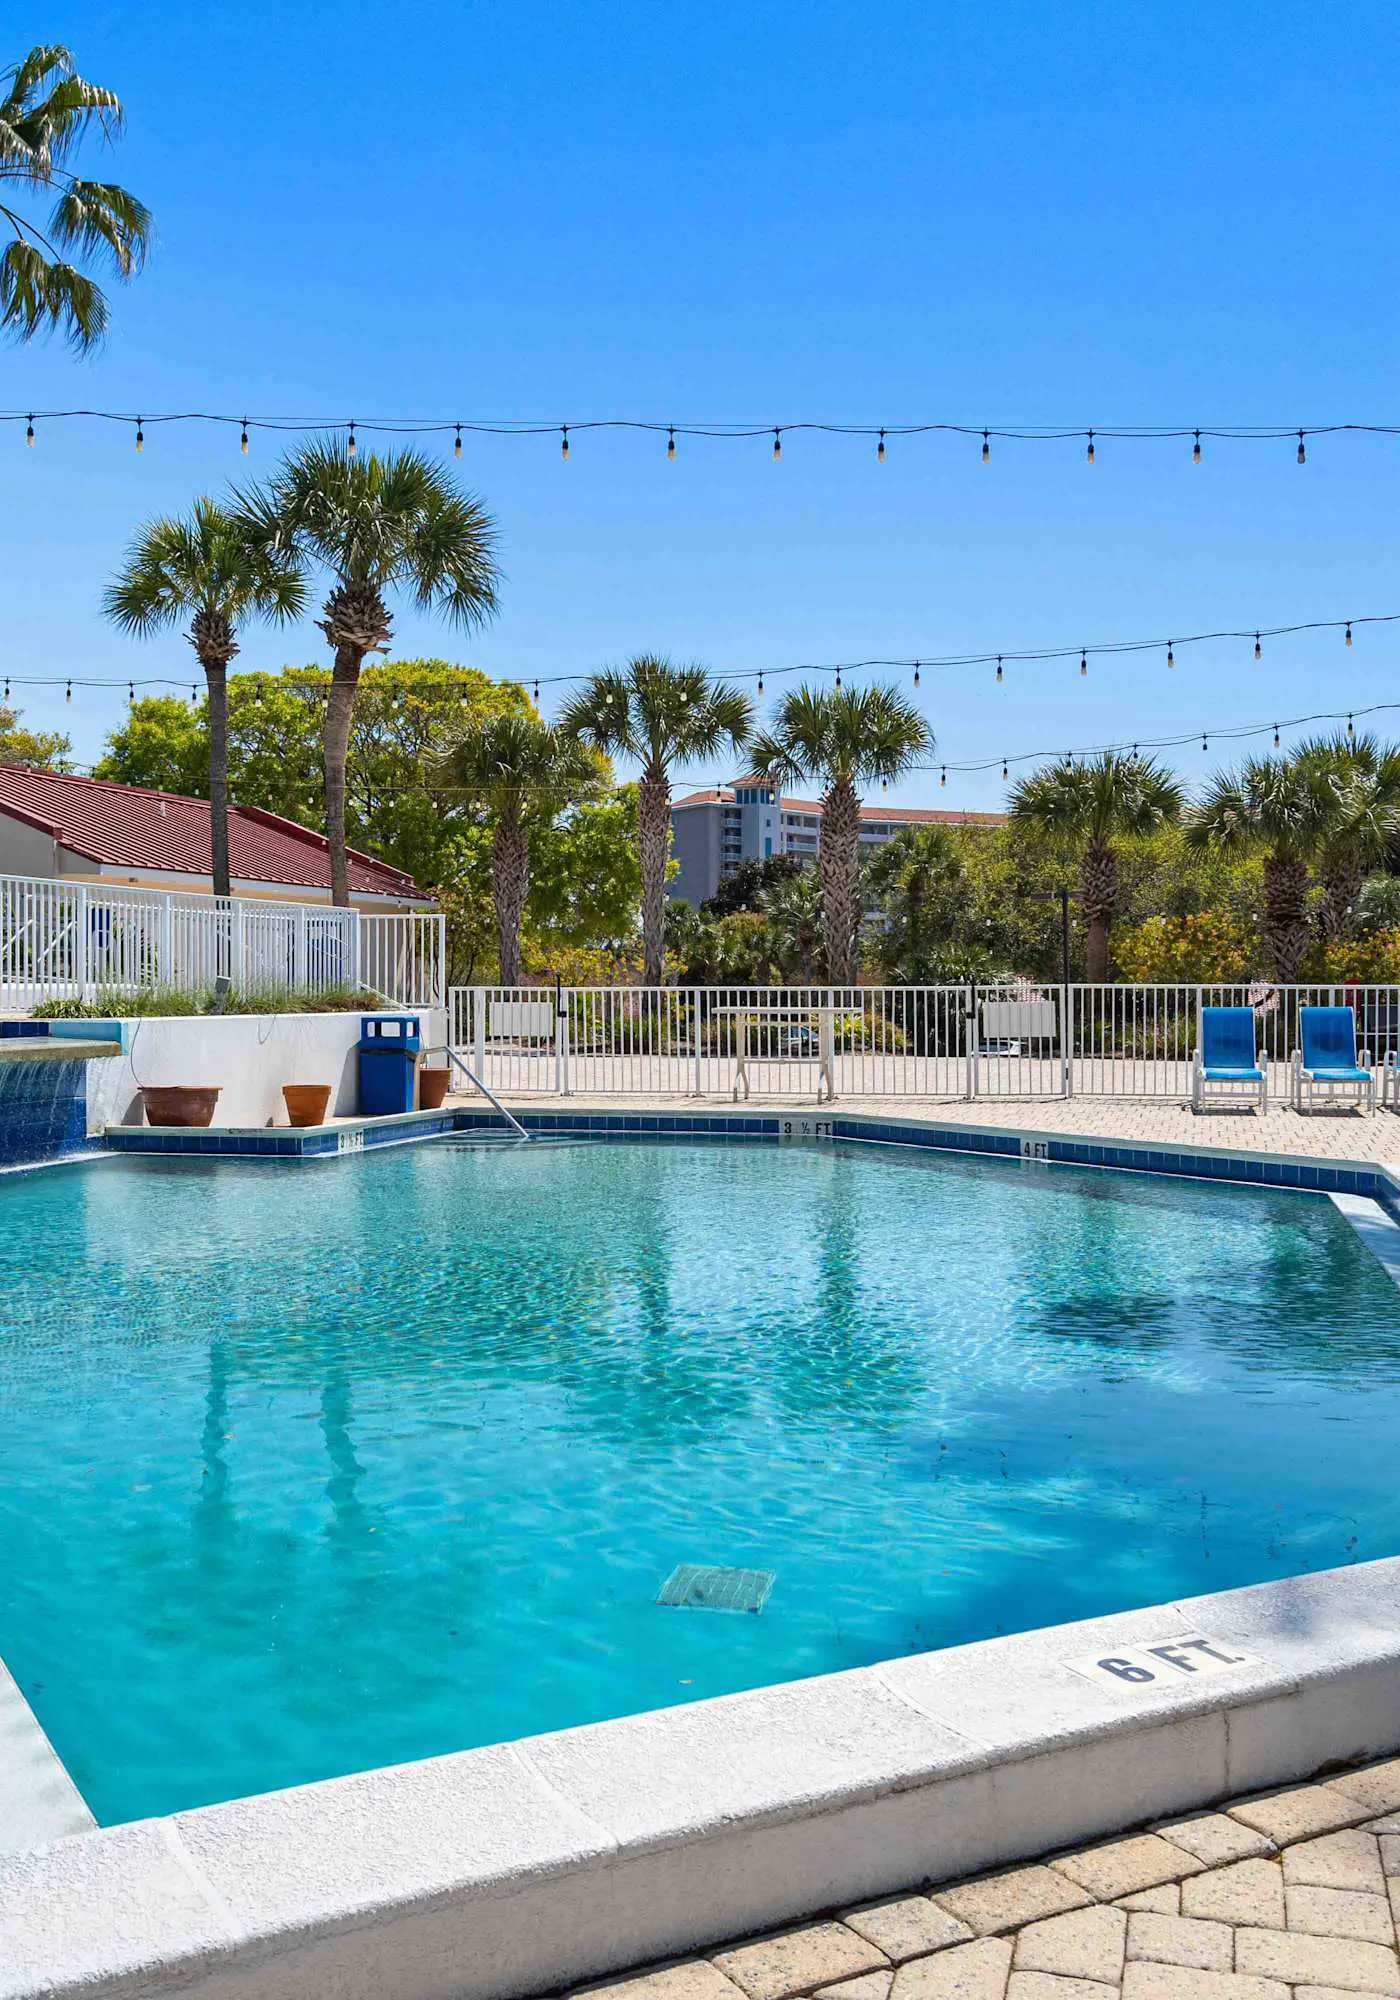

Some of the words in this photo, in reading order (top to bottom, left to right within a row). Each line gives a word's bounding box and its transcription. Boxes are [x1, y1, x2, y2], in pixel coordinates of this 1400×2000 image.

[784, 1122, 792, 1134] 3
[1024, 1141, 1030, 1157] 4
[1096, 1658, 1156, 1683] 6
[1147, 1639, 1246, 1672] FT.
